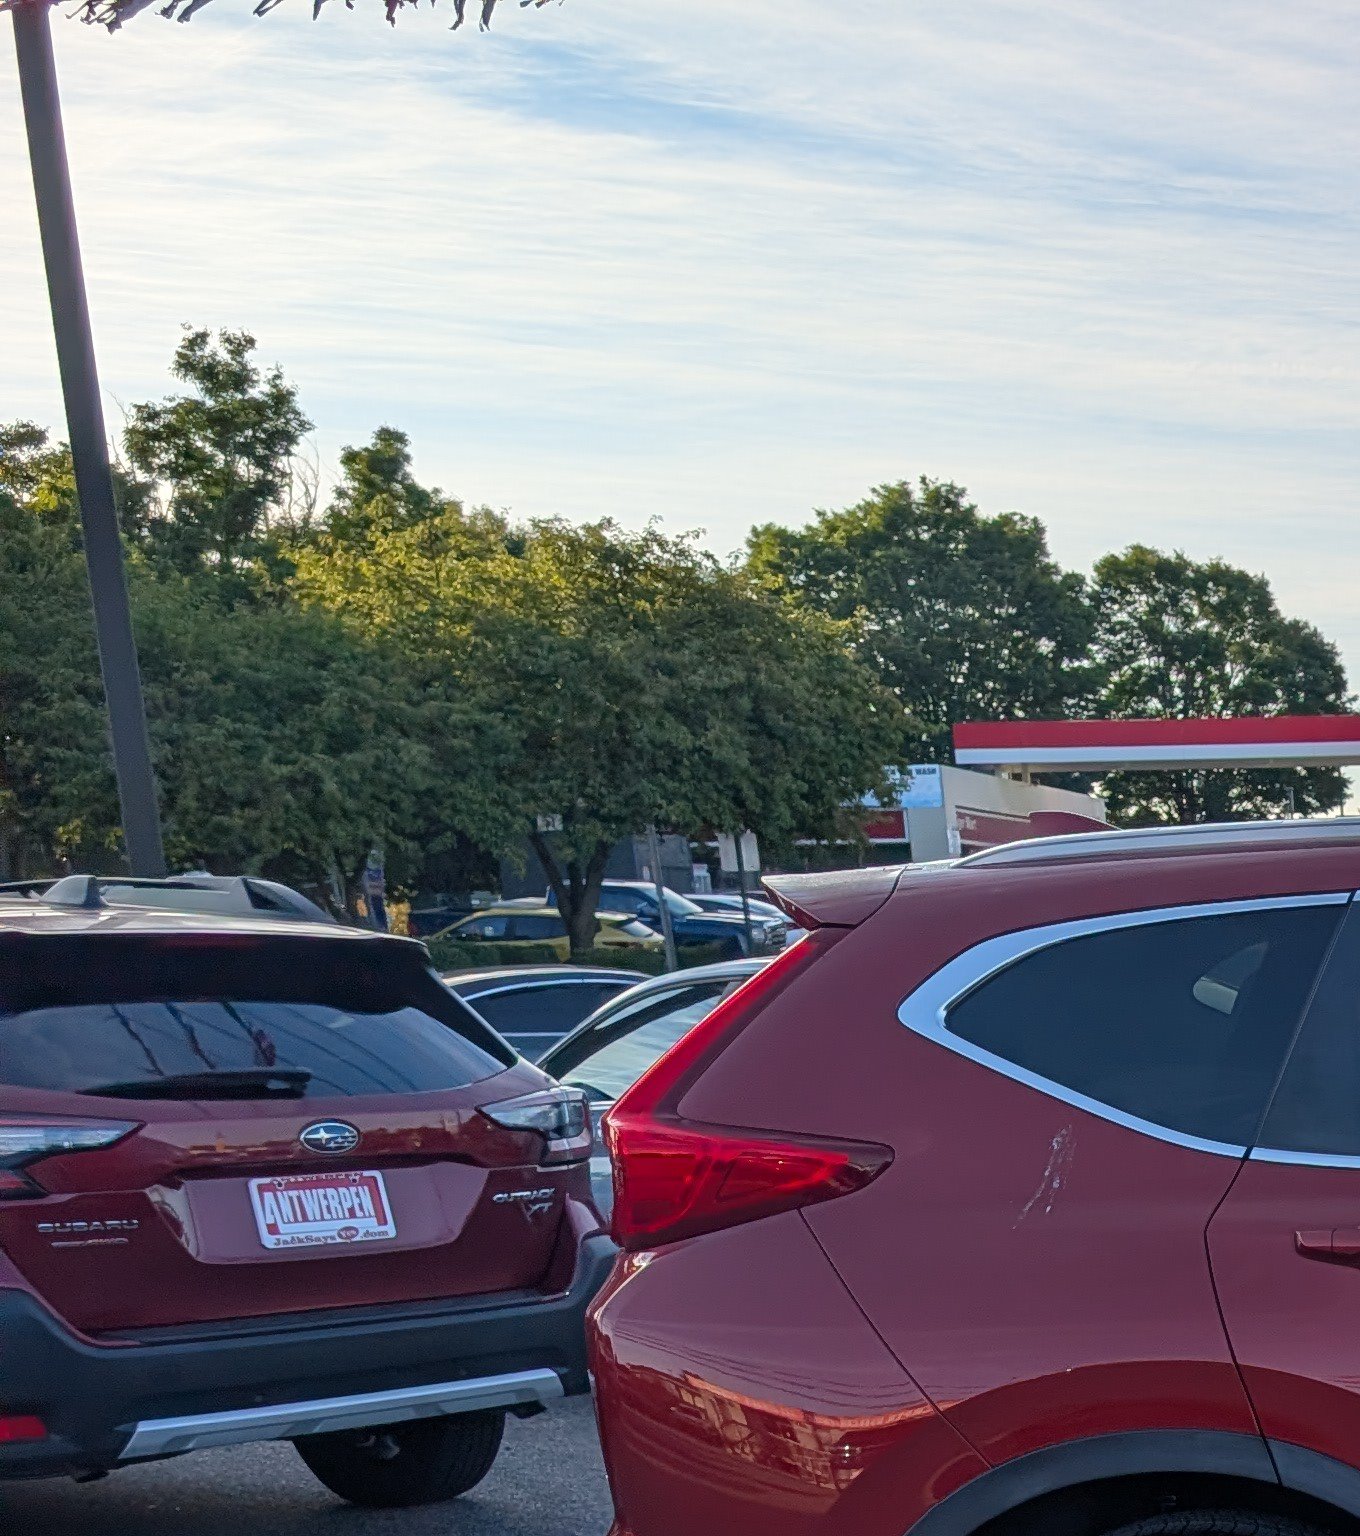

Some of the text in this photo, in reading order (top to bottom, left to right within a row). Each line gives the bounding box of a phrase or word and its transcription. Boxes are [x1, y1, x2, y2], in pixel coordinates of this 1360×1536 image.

[914, 767, 937, 775] WASH
[492, 1187, 556, 1203] OUTBACK
[263, 1184, 376, 1224] ANTWERPEN
[37, 1219, 139, 1233] SUBARU
[273, 1234, 337, 1247] JackSays
